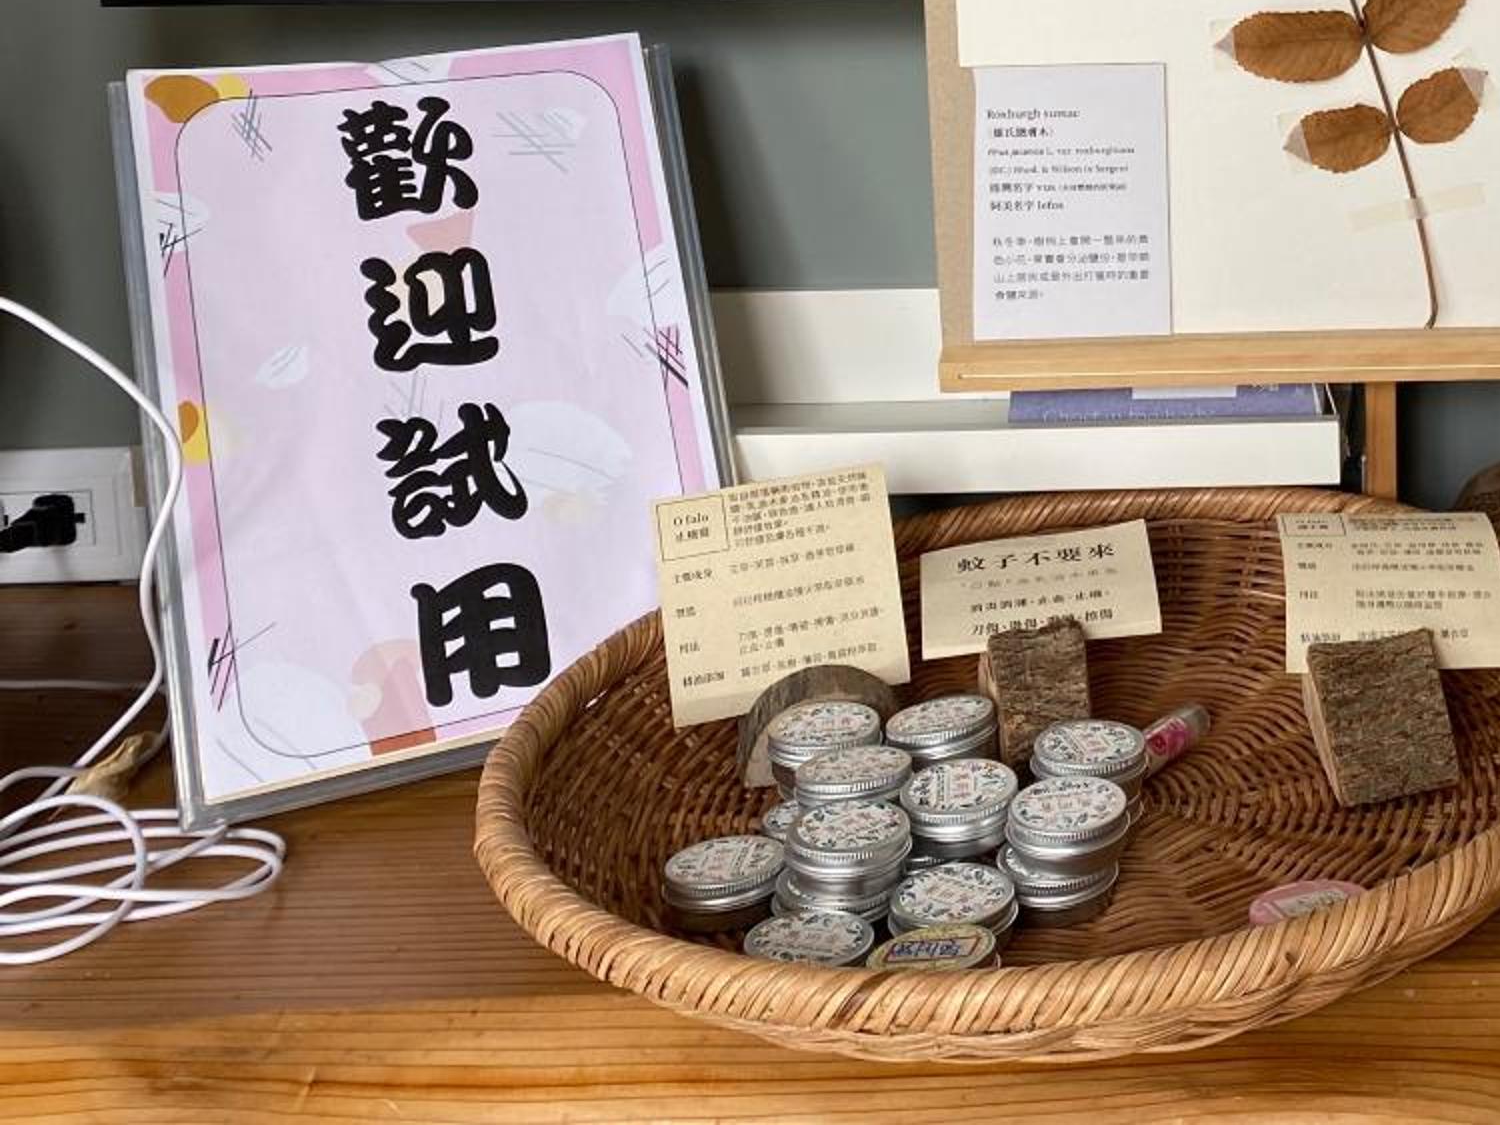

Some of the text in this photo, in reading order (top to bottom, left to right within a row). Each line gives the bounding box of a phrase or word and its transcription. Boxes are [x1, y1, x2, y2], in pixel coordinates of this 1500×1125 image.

[338, 96, 552, 708] 歡迎試用
[957, 542, 1115, 573] 蚊子不要來
